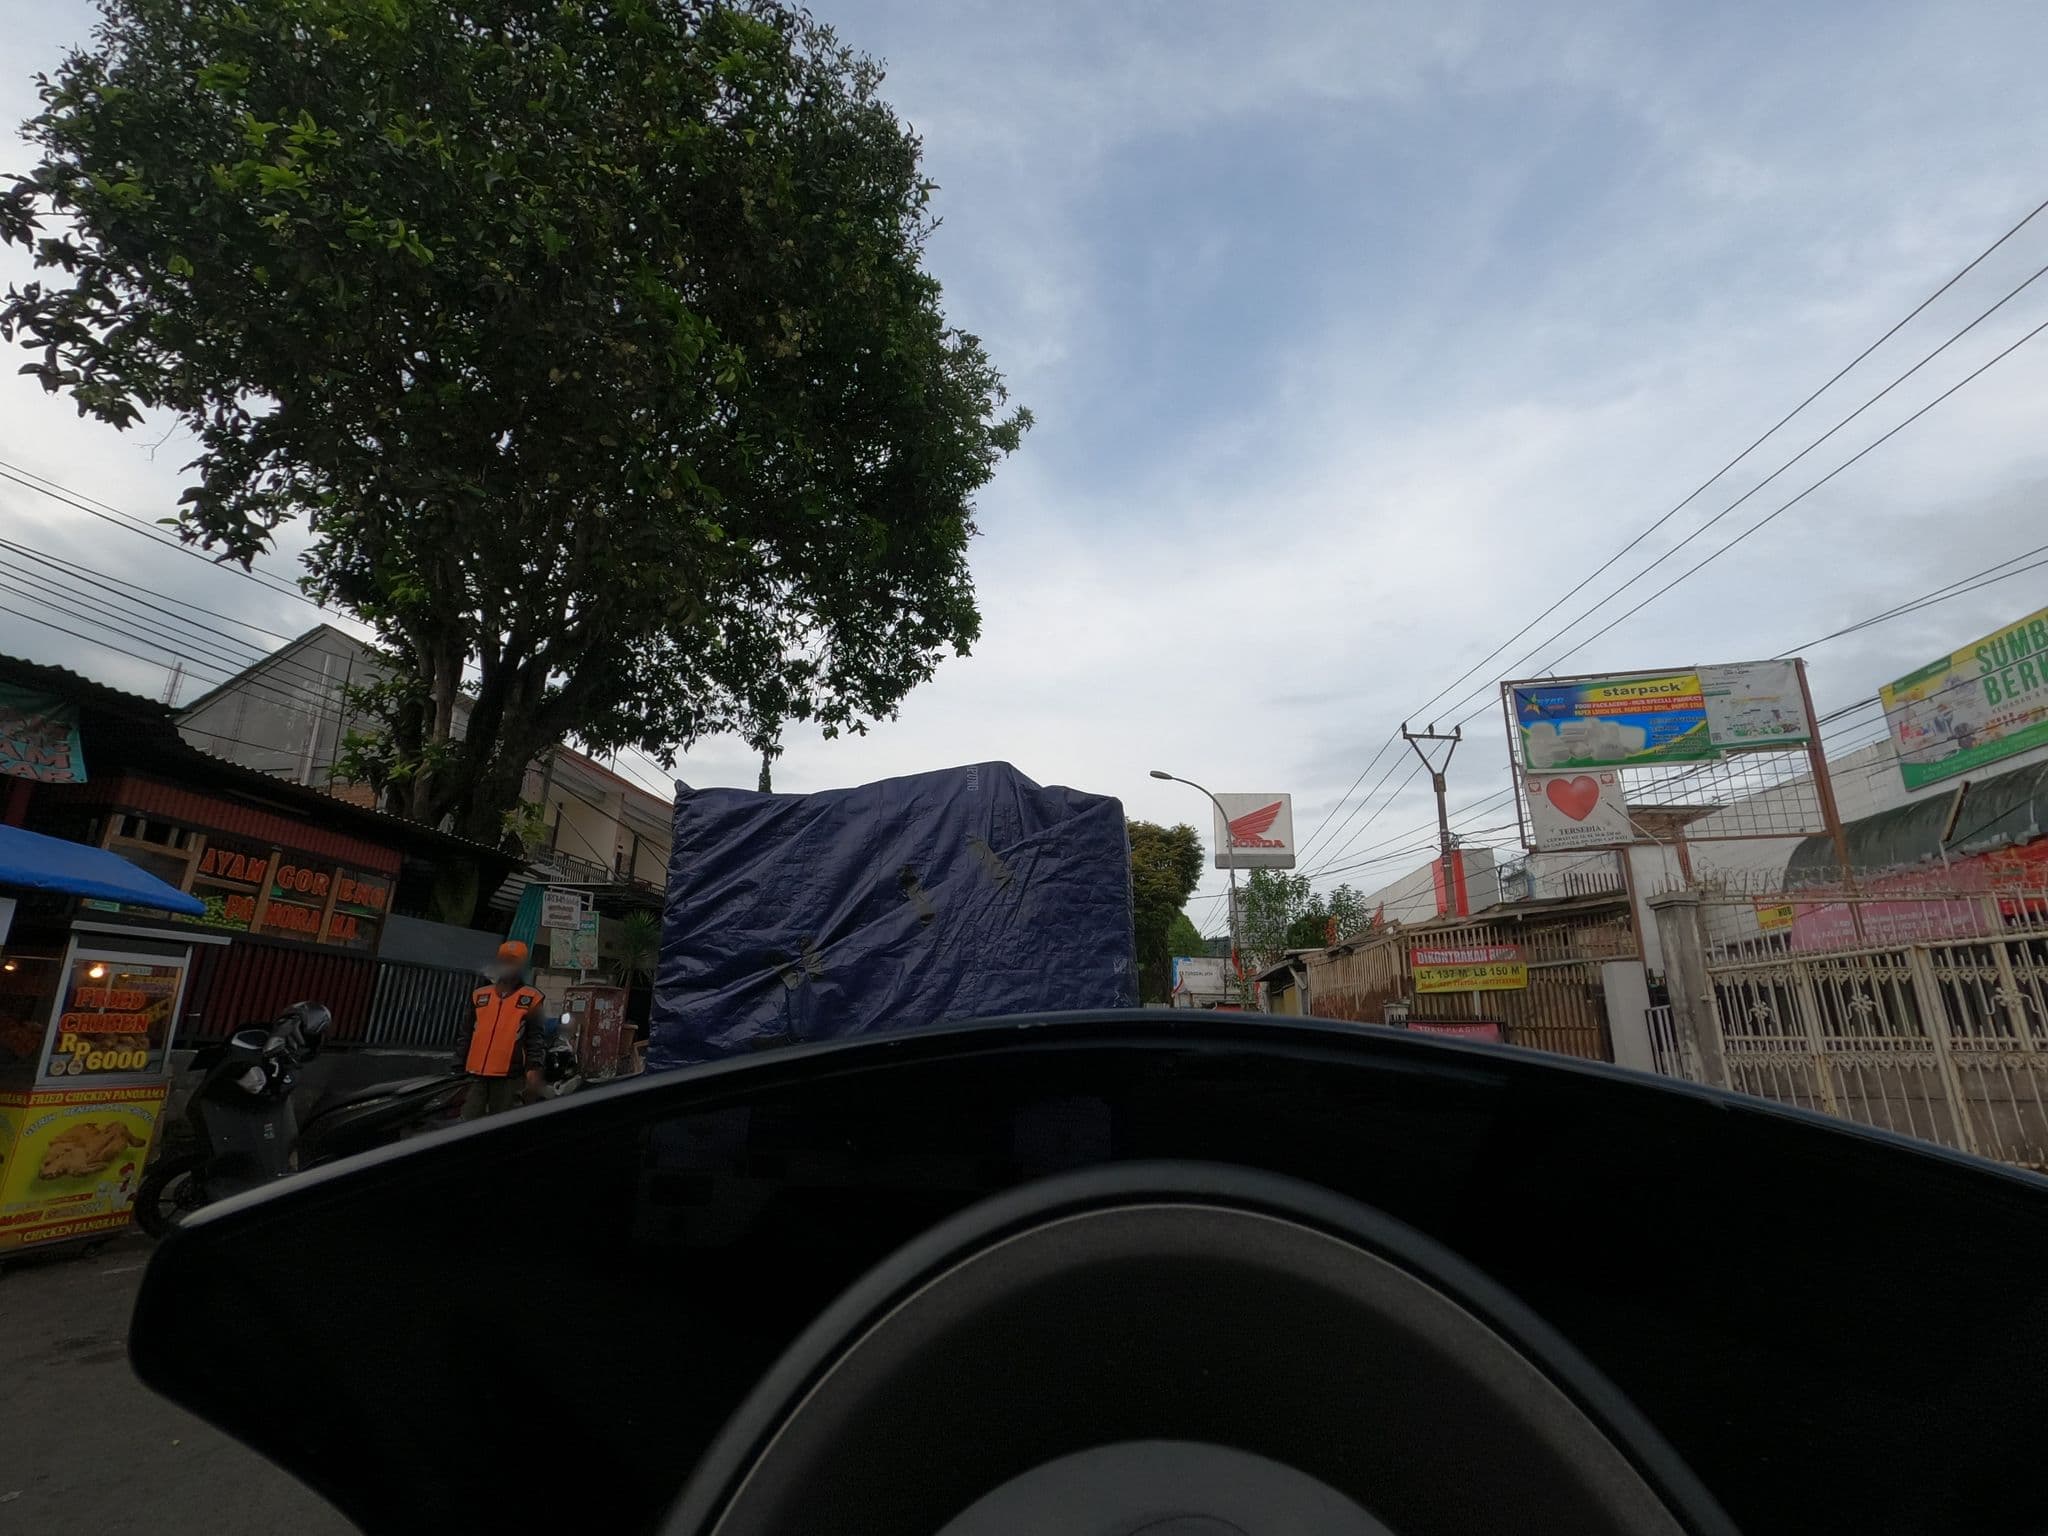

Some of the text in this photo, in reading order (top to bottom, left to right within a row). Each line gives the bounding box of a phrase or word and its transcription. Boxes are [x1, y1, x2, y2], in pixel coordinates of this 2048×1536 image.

[1975, 614, 2048, 674] SUMB
[1603, 683, 1681, 697] starpack
[1559, 825, 1602, 836] TERSEDIA
[1226, 839, 1285, 848] HONDA
[199, 848, 267, 883] AYAM
[1417, 948, 1488, 964] DIKONTRAKAN
[1474, 967, 1487, 977] LB
[1490, 966, 1508, 975] 150
[30, 1088, 165, 1105] FRIED CHICKEN PANORAMA
[23, 1226, 73, 1243] CHICKEN
[75, 1215, 130, 1233] PANORAMA
